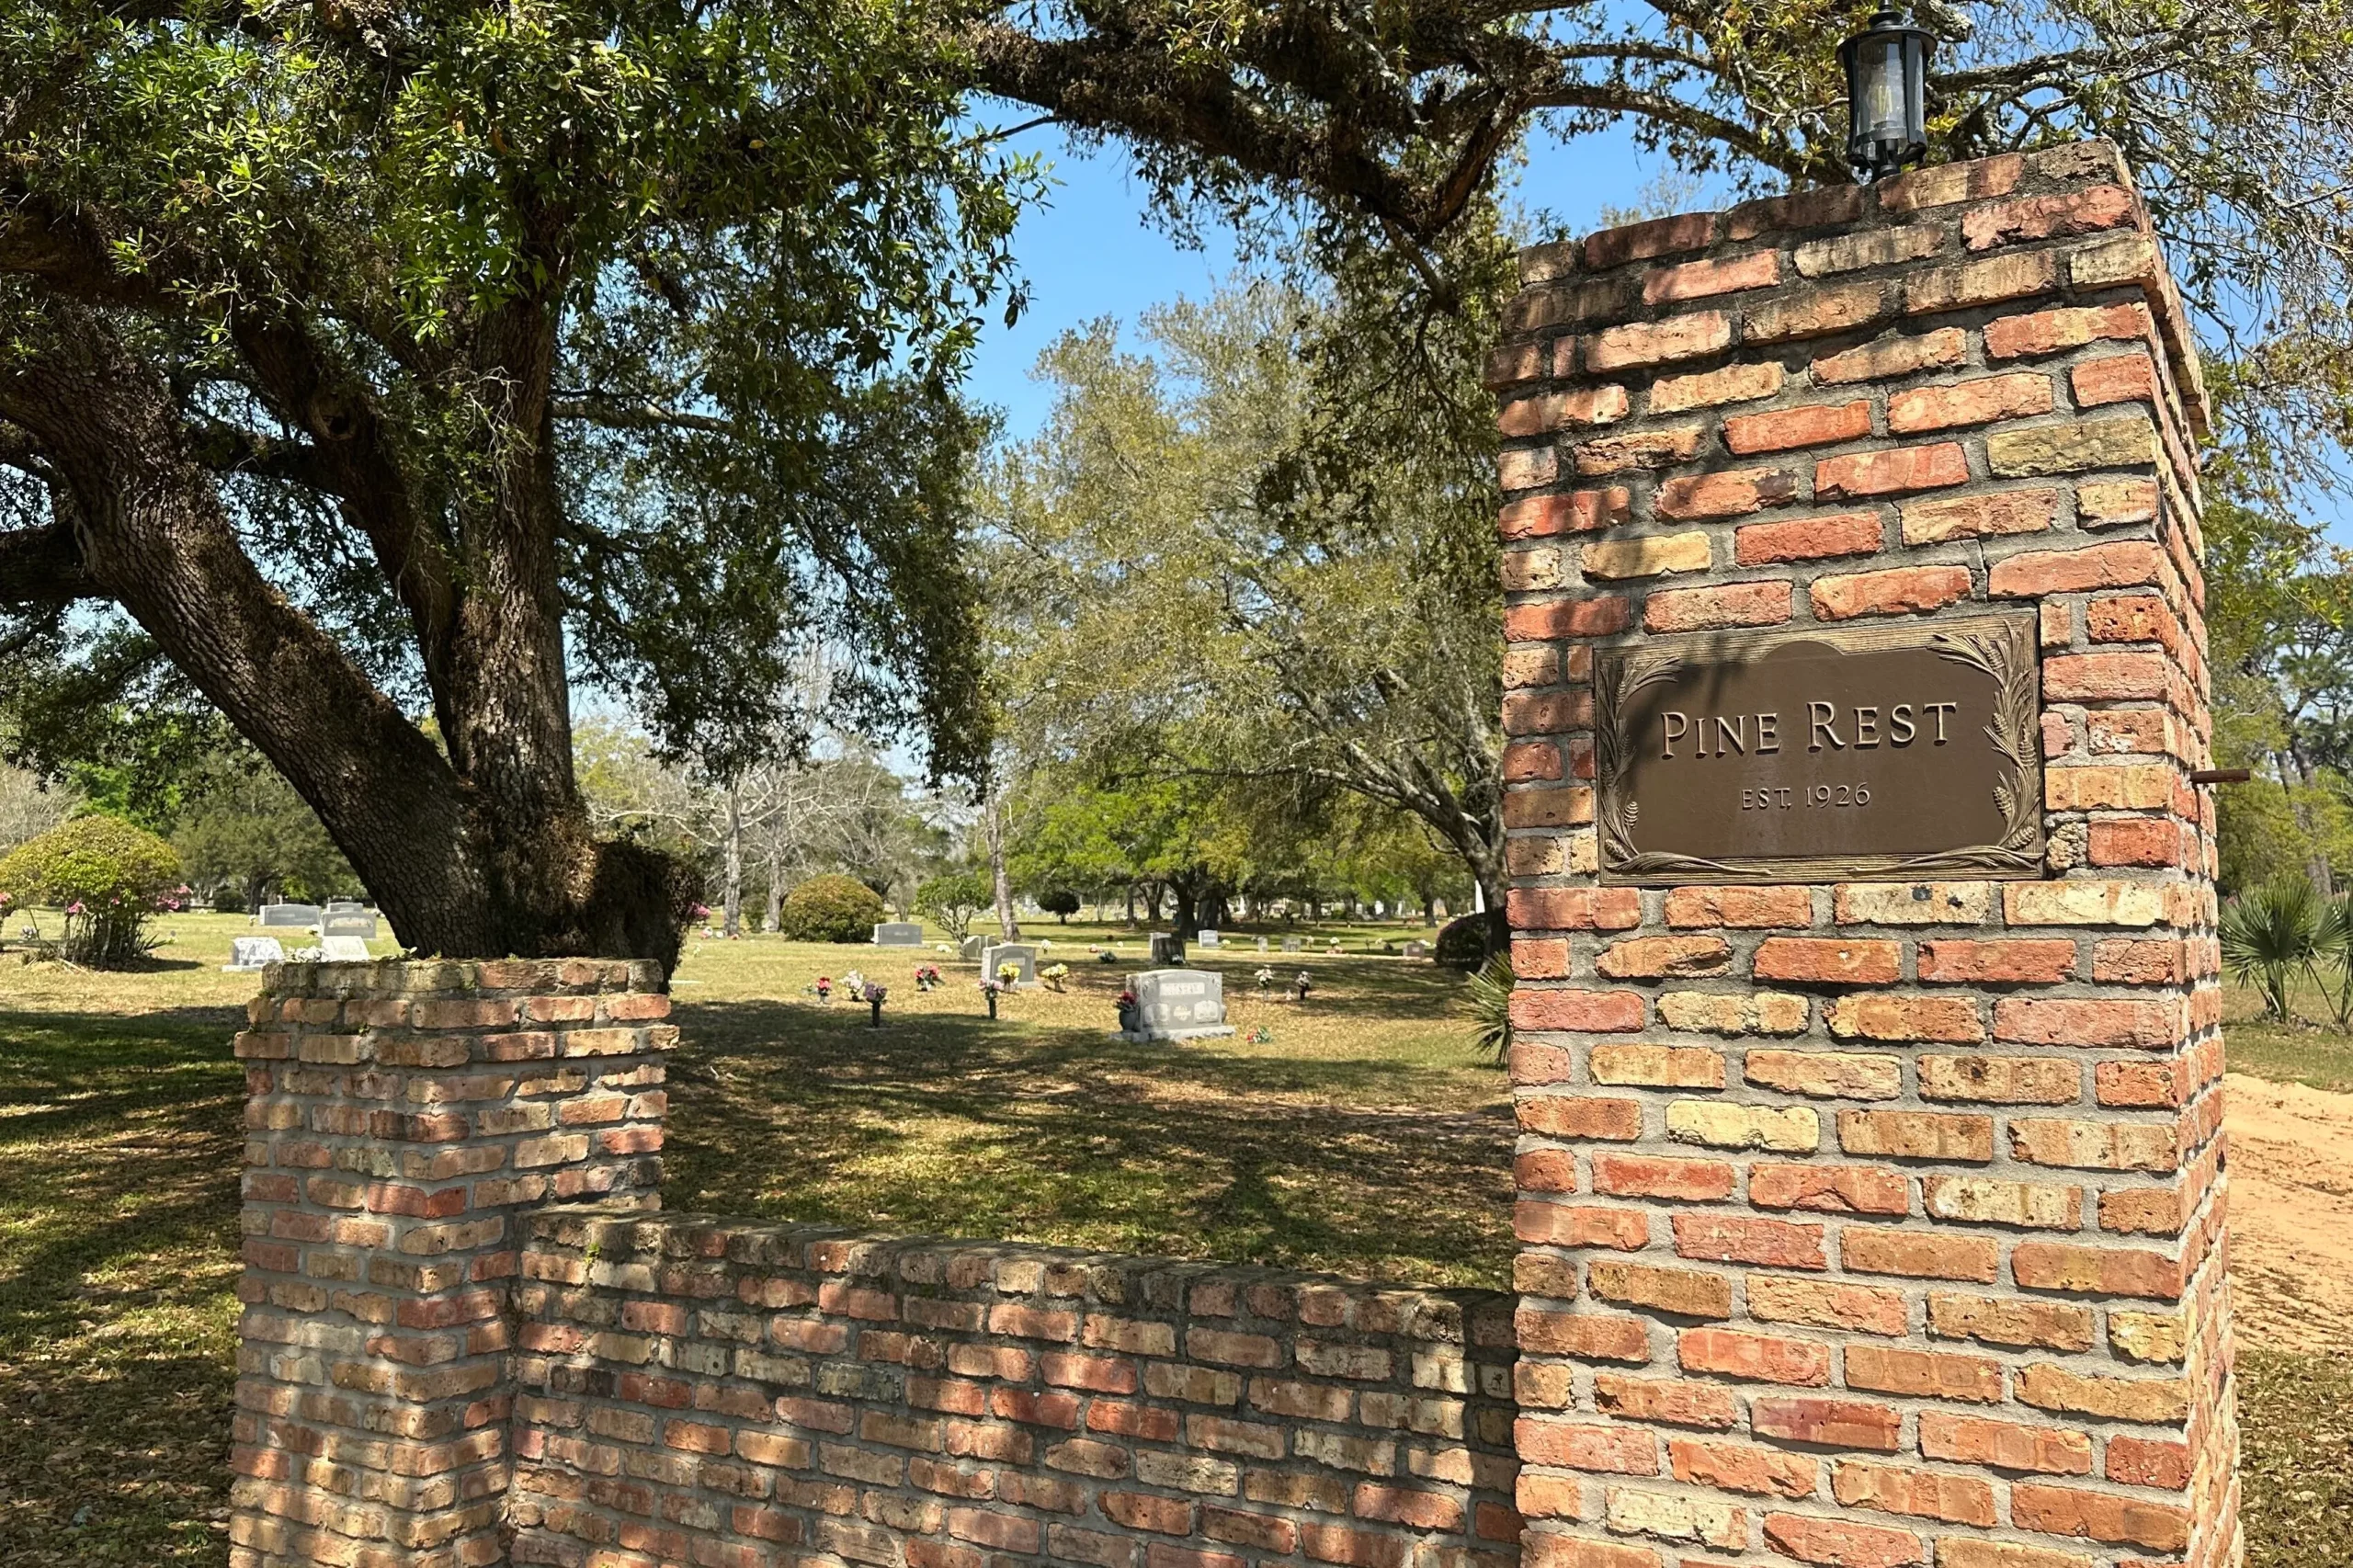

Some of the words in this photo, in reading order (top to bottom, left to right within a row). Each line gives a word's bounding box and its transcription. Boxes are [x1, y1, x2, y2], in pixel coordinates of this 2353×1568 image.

[1661, 711, 1782, 759] PINE
[1806, 701, 1958, 752] REST
[1742, 787, 1792, 811] EST.
[1804, 782, 1871, 808] 1926
